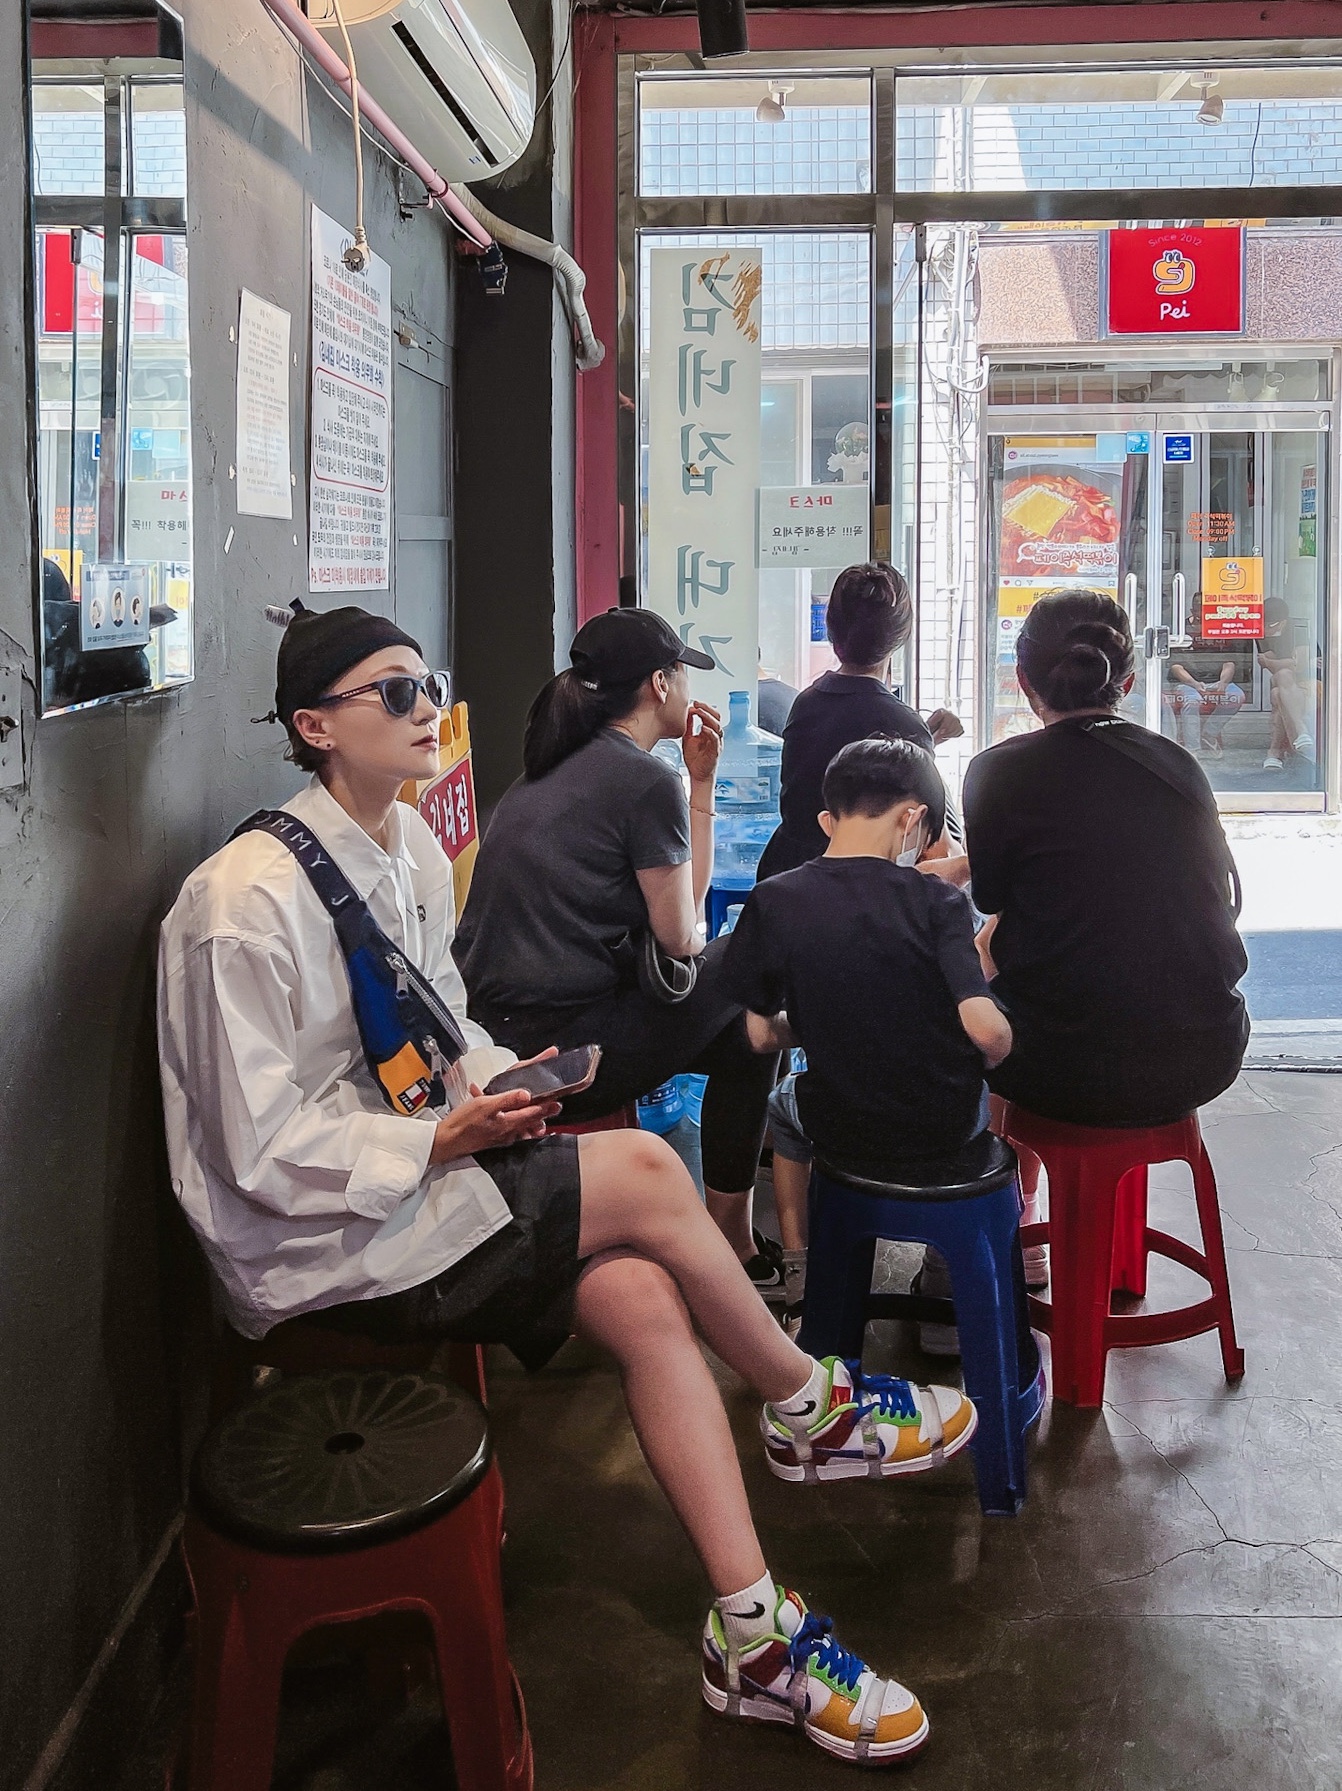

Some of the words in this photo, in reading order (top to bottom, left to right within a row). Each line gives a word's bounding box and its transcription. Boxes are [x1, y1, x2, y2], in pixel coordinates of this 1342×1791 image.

[1148, 234, 1177, 247] Since
[1180, 232, 1202, 246] 2012
[1160, 299, 1191, 320] Pei
[131, 520, 151, 530] 꼭!!!
